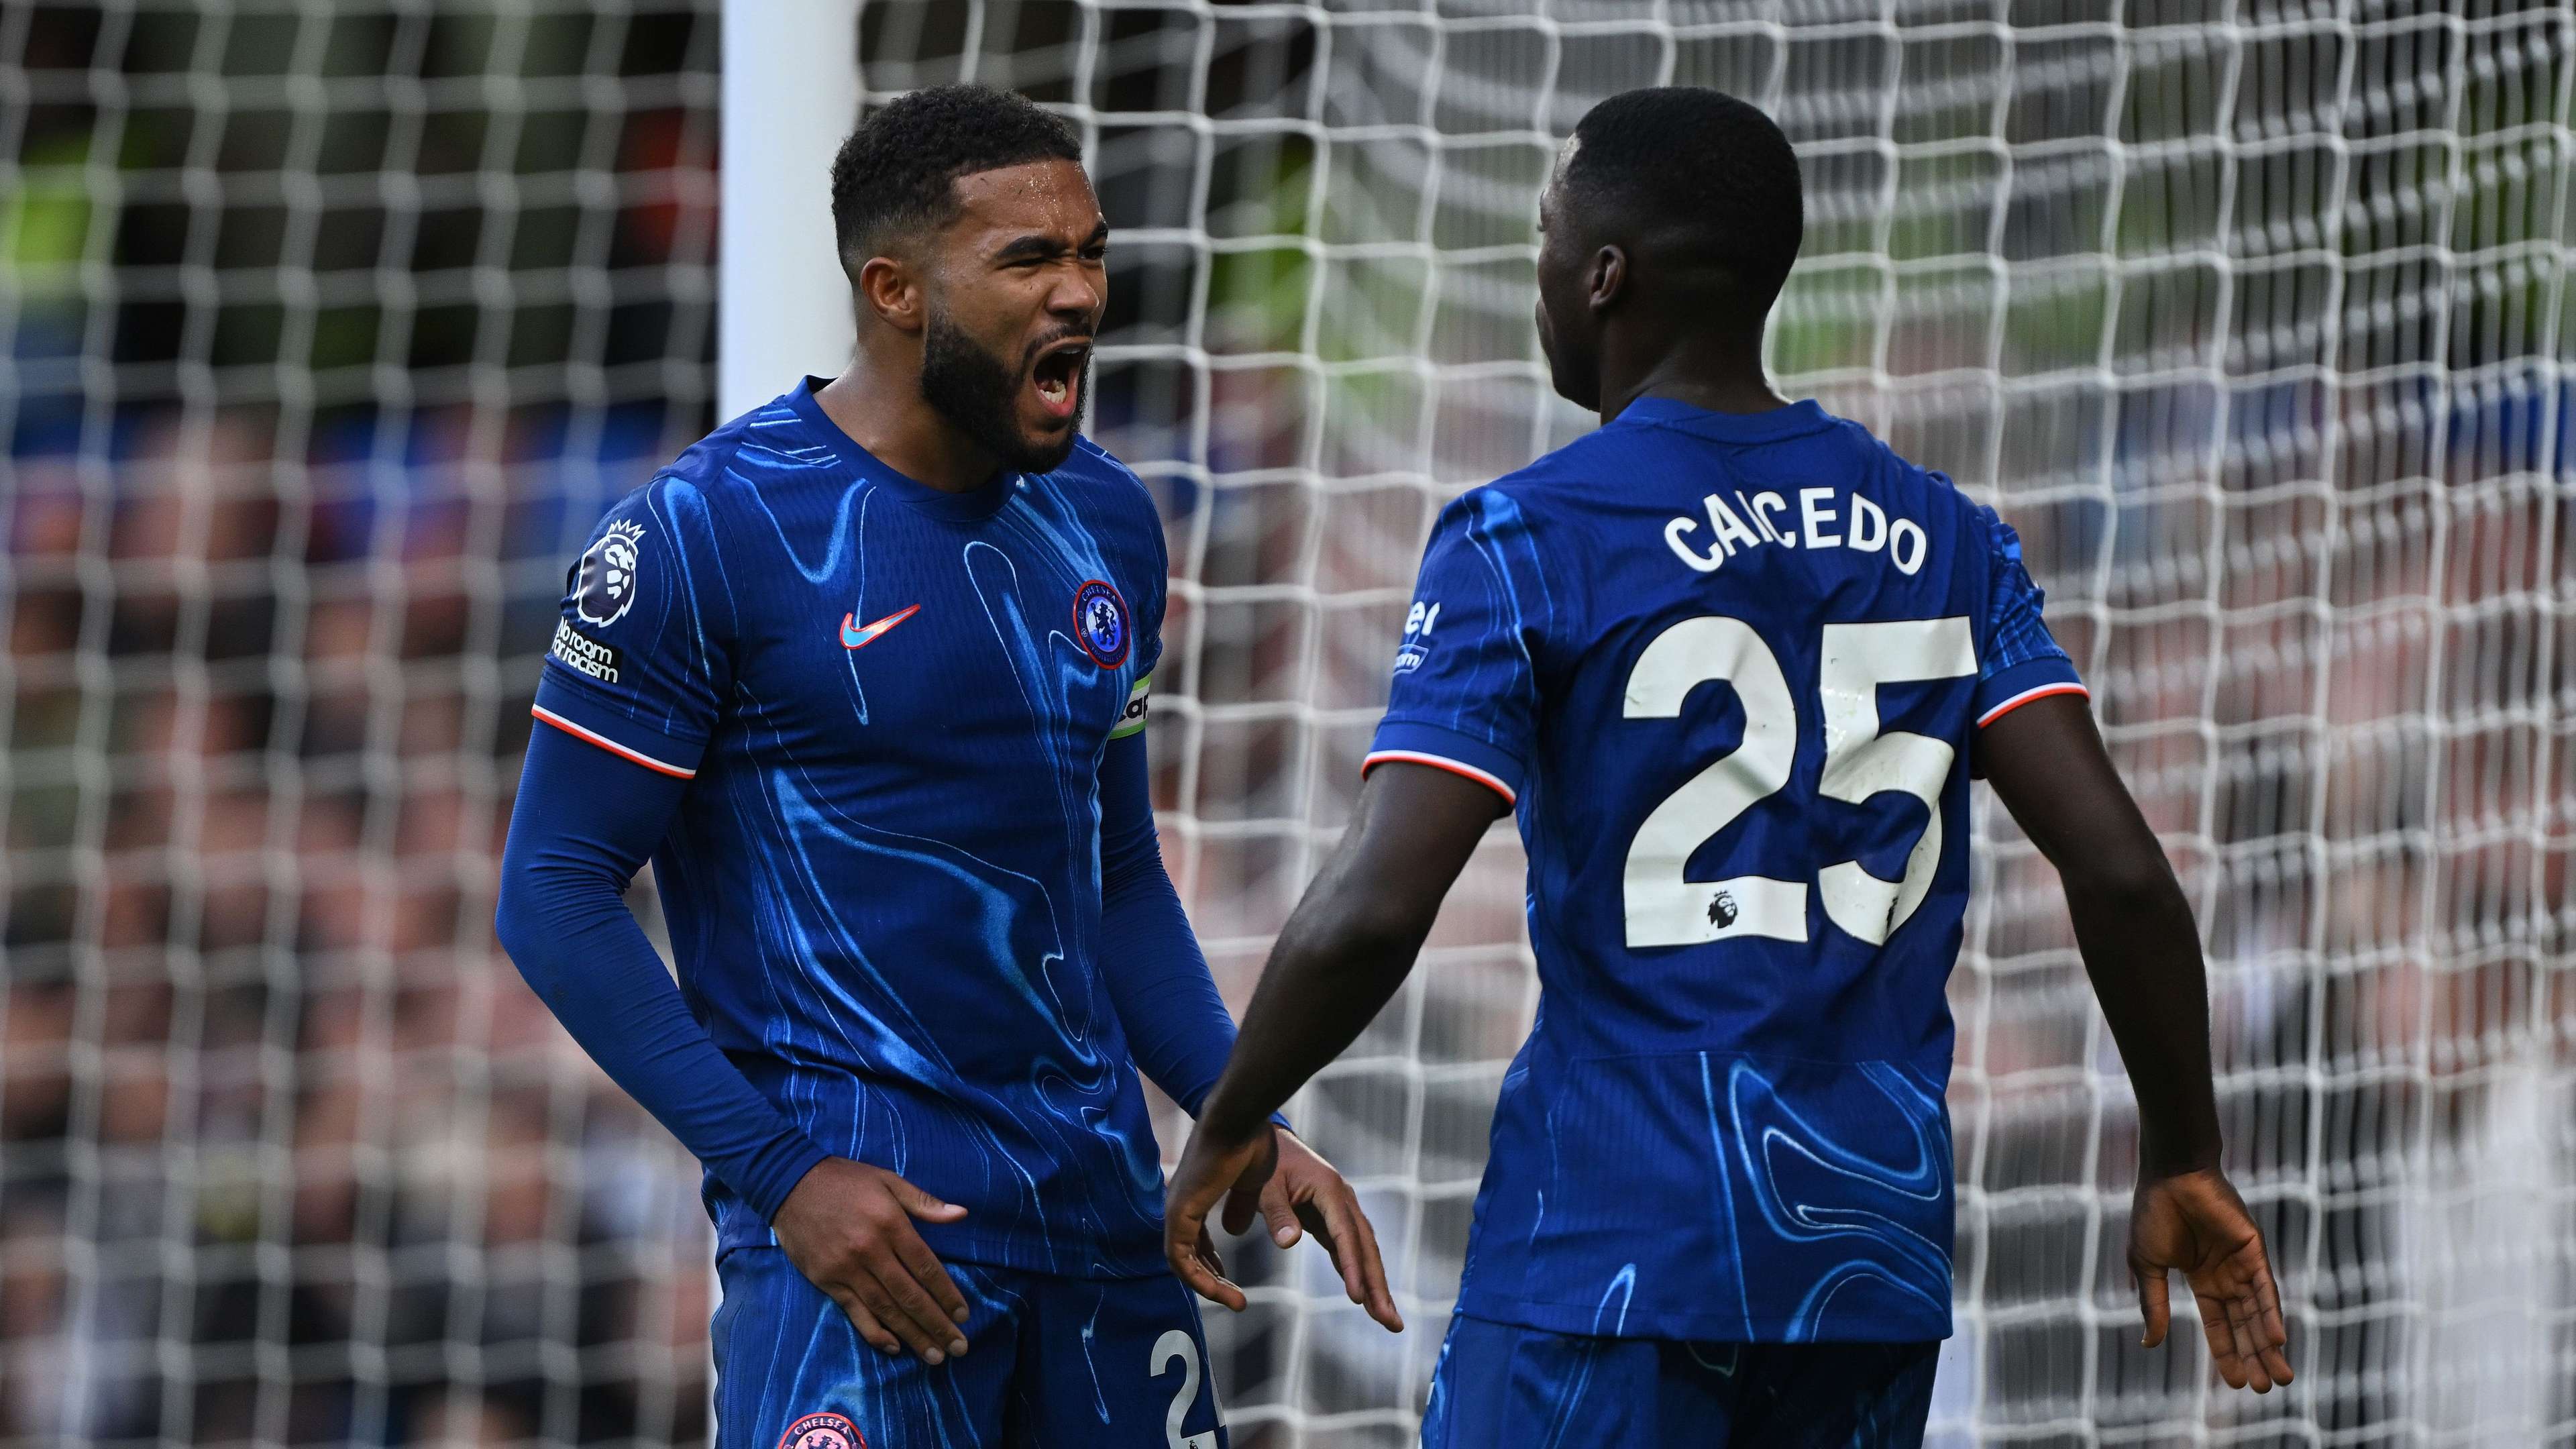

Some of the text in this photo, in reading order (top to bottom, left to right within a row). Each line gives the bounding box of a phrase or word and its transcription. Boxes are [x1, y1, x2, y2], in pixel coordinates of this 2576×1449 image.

[1664, 487, 1927, 576] CAICEDO
[1081, 584, 1116, 602] CHELSEA
[562, 646, 618, 683] racism
[569, 631, 612, 665] room
[1623, 615, 1978, 948] 25
[794, 1417, 849, 1436] CHELSEA
